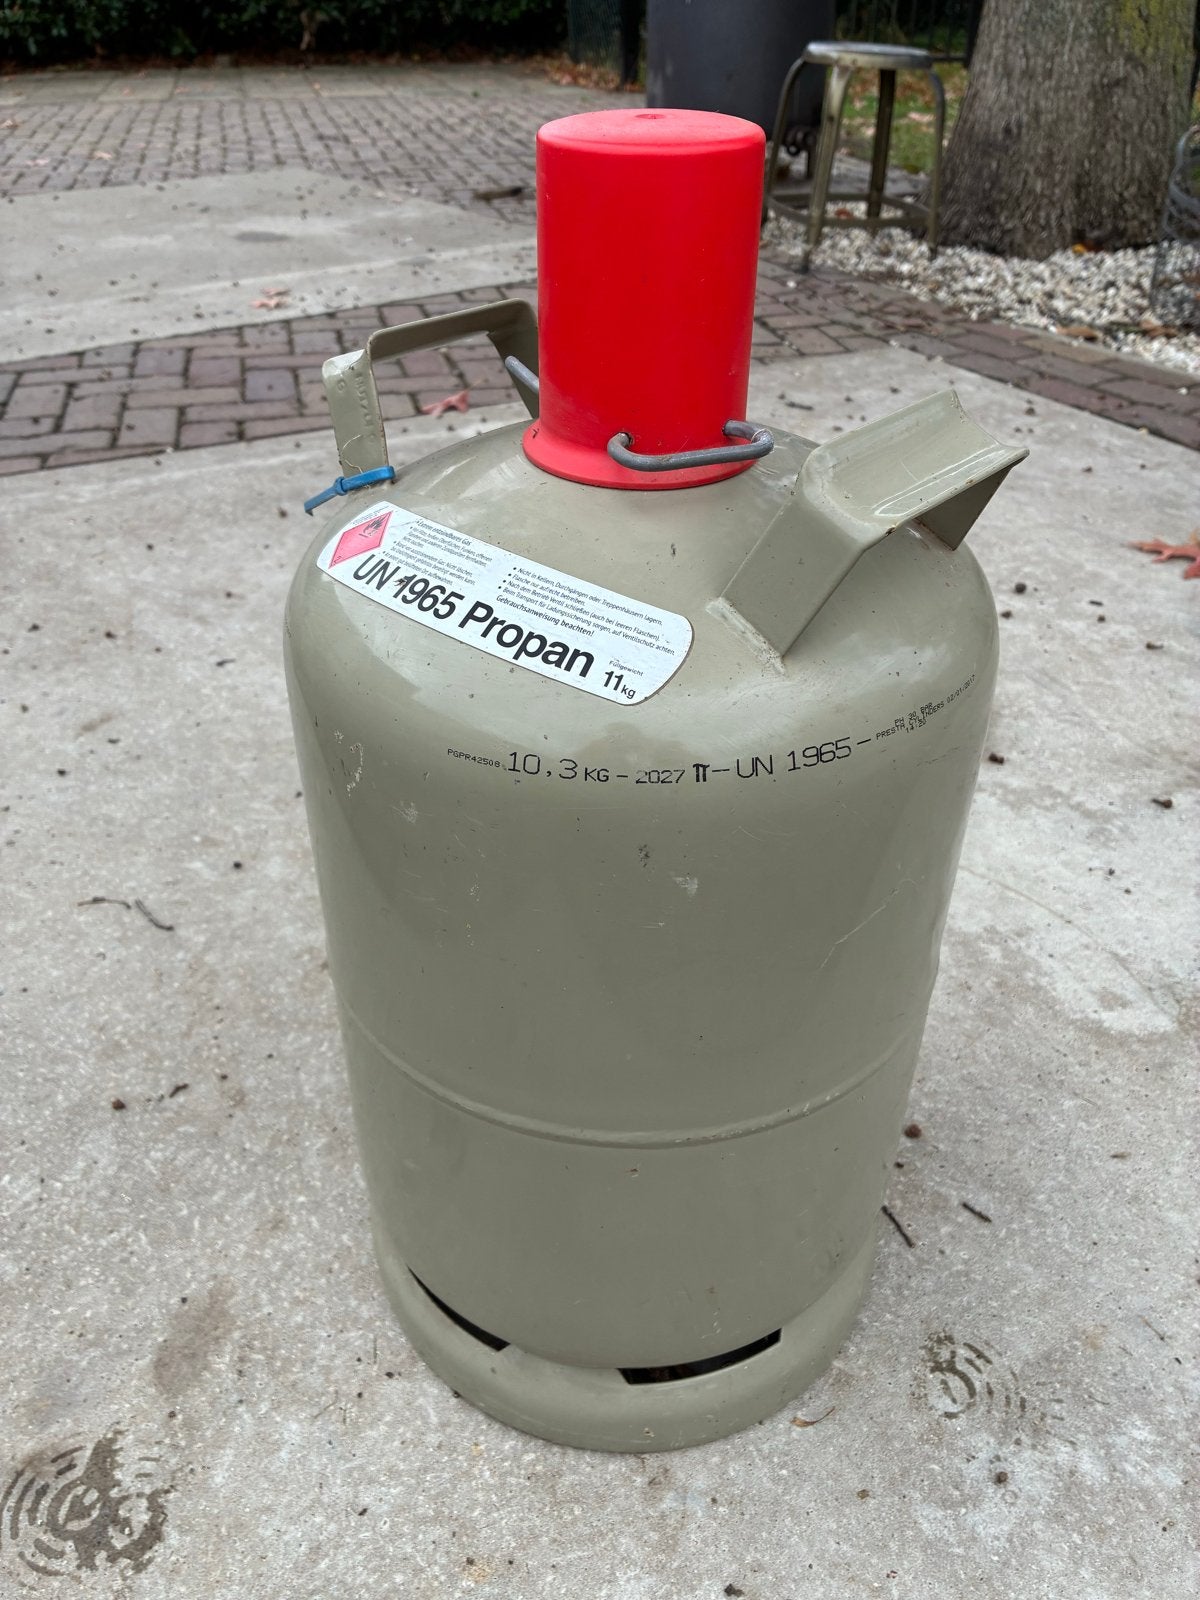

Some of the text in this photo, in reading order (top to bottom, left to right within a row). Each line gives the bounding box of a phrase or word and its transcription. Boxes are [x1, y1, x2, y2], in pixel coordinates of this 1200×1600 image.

[507, 580, 520, 590] Nach
[520, 585, 531, 593] dem
[531, 590, 549, 600] Betrieb
[550, 597, 564, 606] Ventil
[589, 612, 605, 622] (auch
[605, 617, 615, 625] bei
[615, 621, 632, 632] leeren
[512, 574, 531, 585] Flasche
[539, 585, 561, 597] aufrecht
[518, 568, 531, 577] Nicht
[555, 582, 589, 599] Durchgängen
[588, 595, 601, 604] oder
[601, 599, 644, 619] Treppenhäusern
[352, 554, 401, 591] UN
[392, 573, 465, 620] 1965
[458, 600, 595, 678] Propan
[496, 594, 595, 637] Gebrauchsanweisung beachten!
[503, 587, 516, 596] Beim
[516, 591, 538, 607] Transport
[611, 629, 622, 637] auf
[622, 632, 655, 648] Ventilschutz
[608, 660, 644, 677] Füllgewicht
[508, 751, 578, 780] 10,3
[584, 767, 610, 783] KG
[635, 769, 686, 785] 2027
[736, 754, 774, 779] UN
[787, 736, 852, 772] 1965
